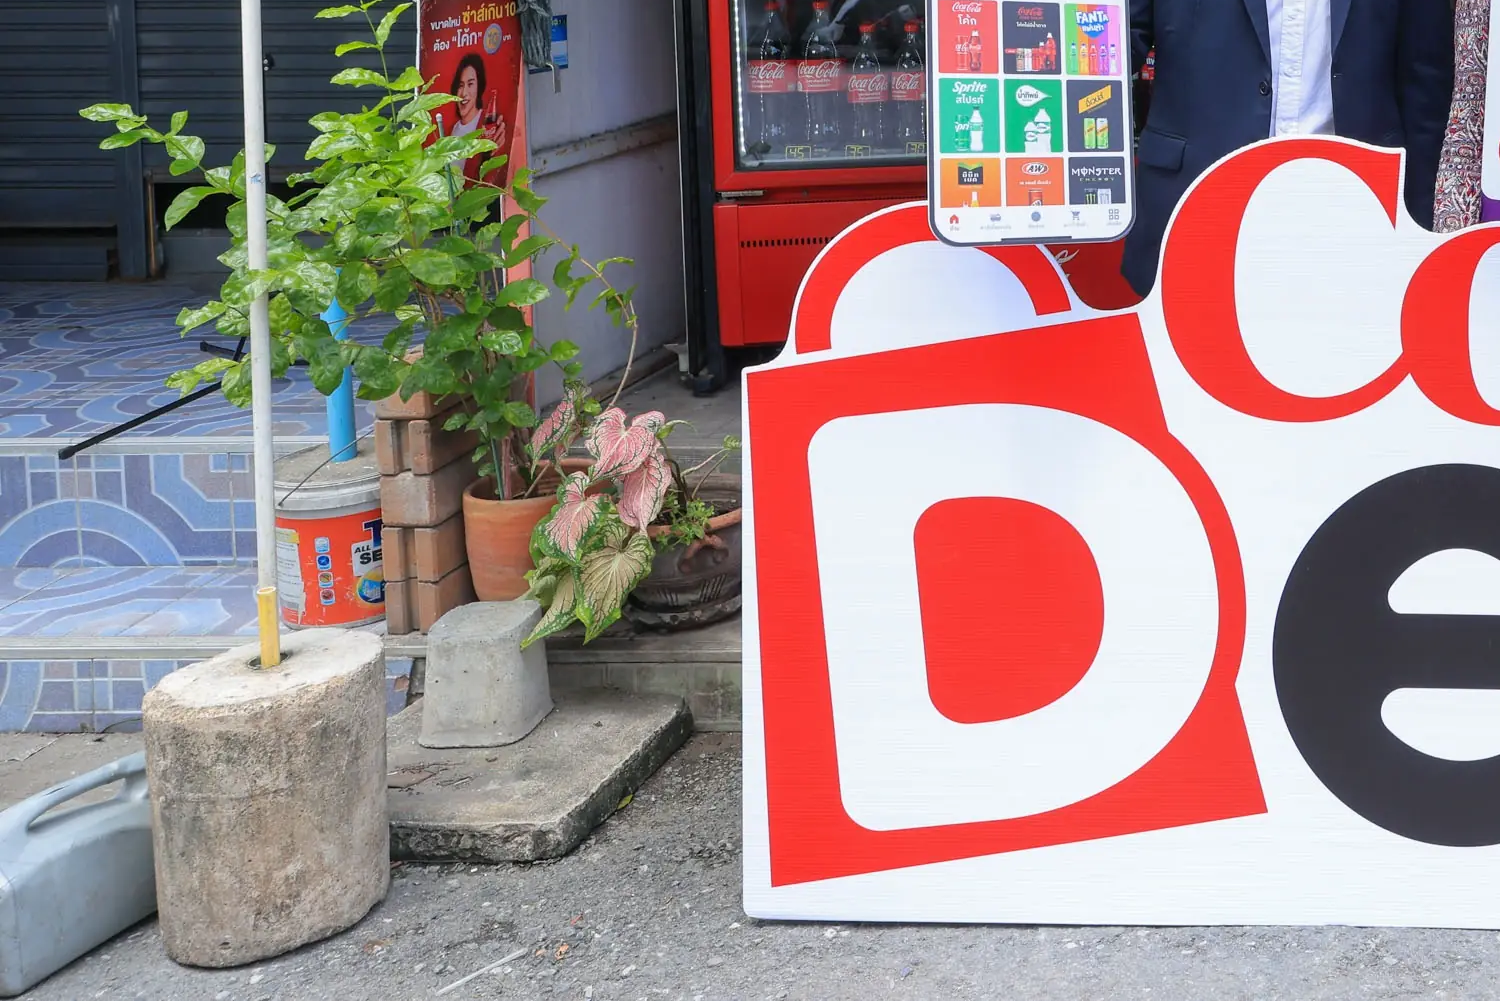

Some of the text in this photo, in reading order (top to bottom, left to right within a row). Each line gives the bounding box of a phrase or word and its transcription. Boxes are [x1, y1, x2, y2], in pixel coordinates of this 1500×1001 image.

[504, 1, 517, 17] 10
[951, 1, 983, 14] Coca-Cola
[957, 13, 977, 26] โค้ก
[1075, 9, 1109, 25] FANTA
[433, 38, 450, 52] ต้อง
[951, 80, 988, 94] Sprite
[1071, 166, 1122, 176] MONSTER
[359, 551, 384, 565] SE
